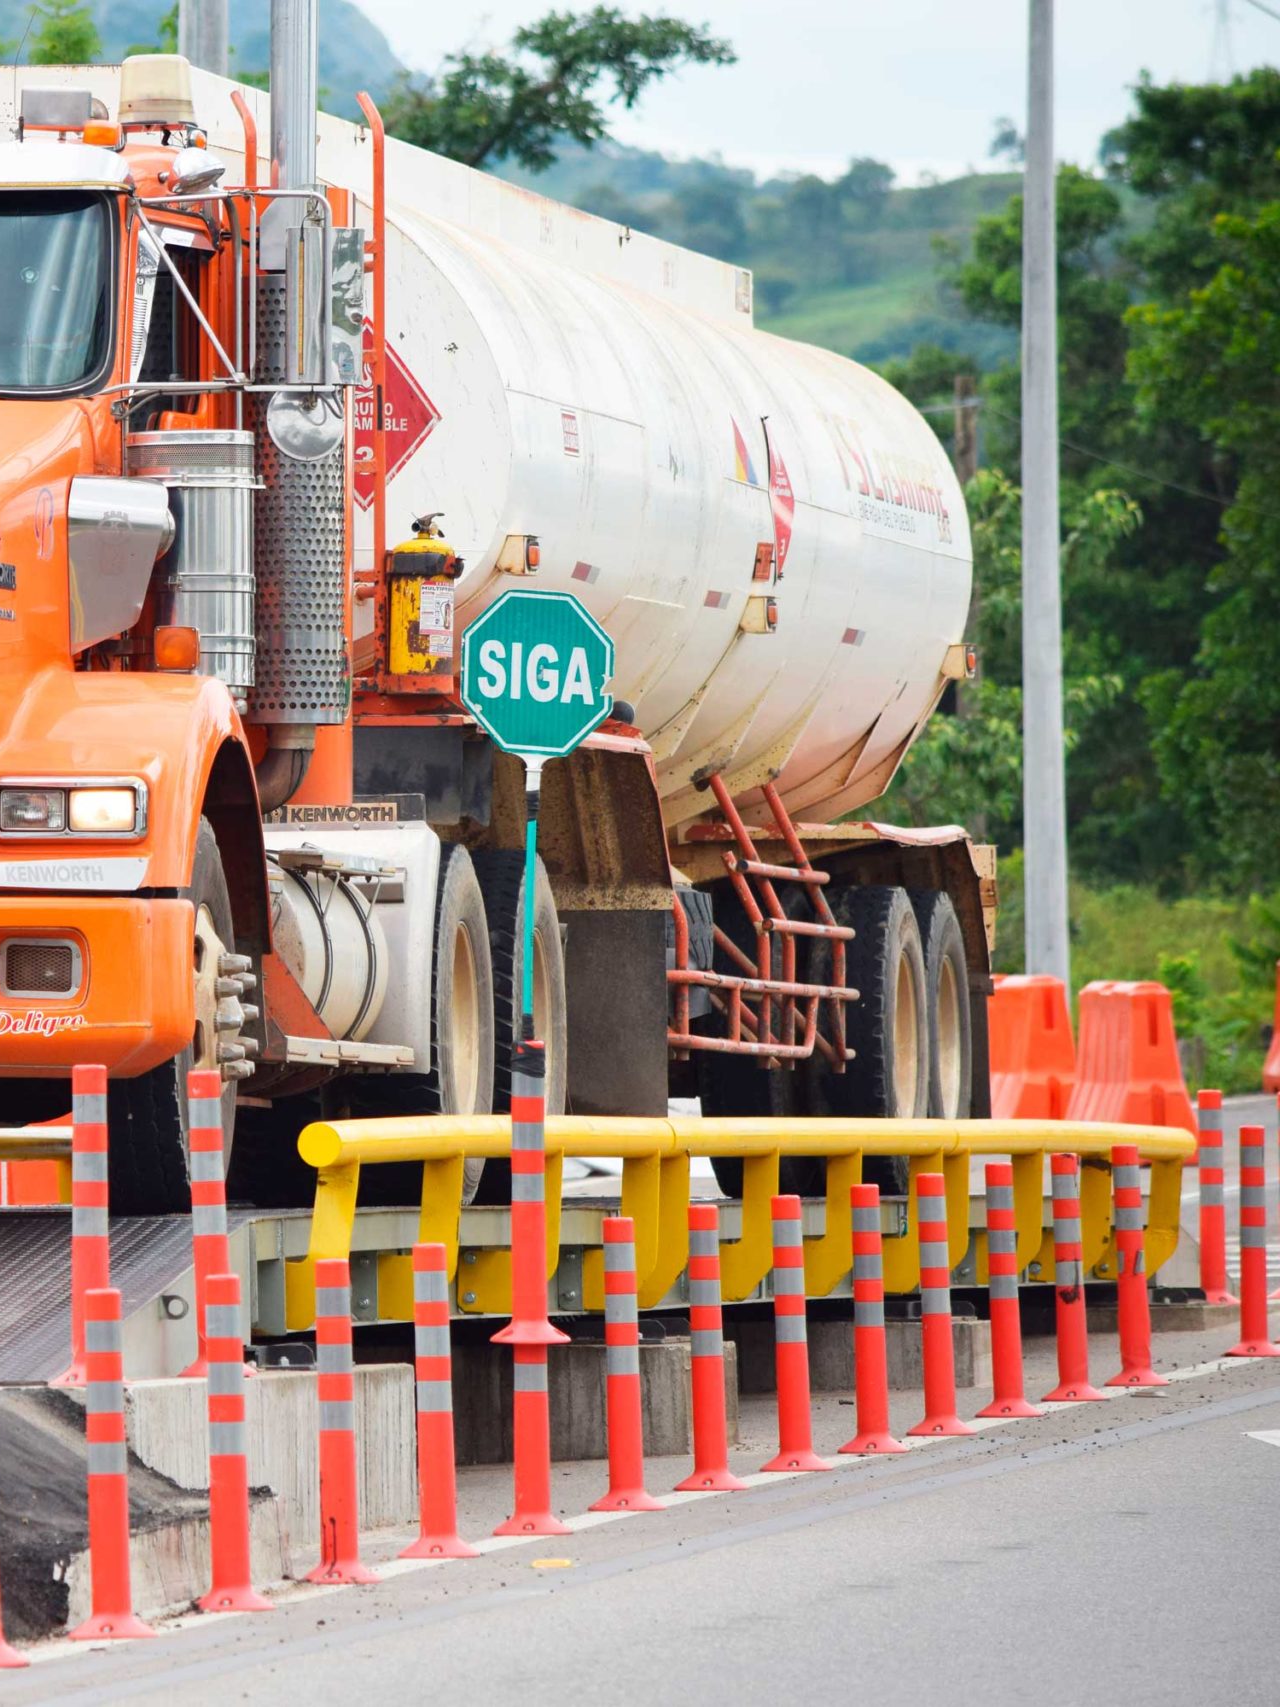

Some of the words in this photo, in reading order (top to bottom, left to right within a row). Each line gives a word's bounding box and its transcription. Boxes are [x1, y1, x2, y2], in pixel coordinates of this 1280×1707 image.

[477, 639, 595, 706] SIGA
[290, 806, 394, 822] KENWORTH
[5, 865, 104, 882] KENWORTH
